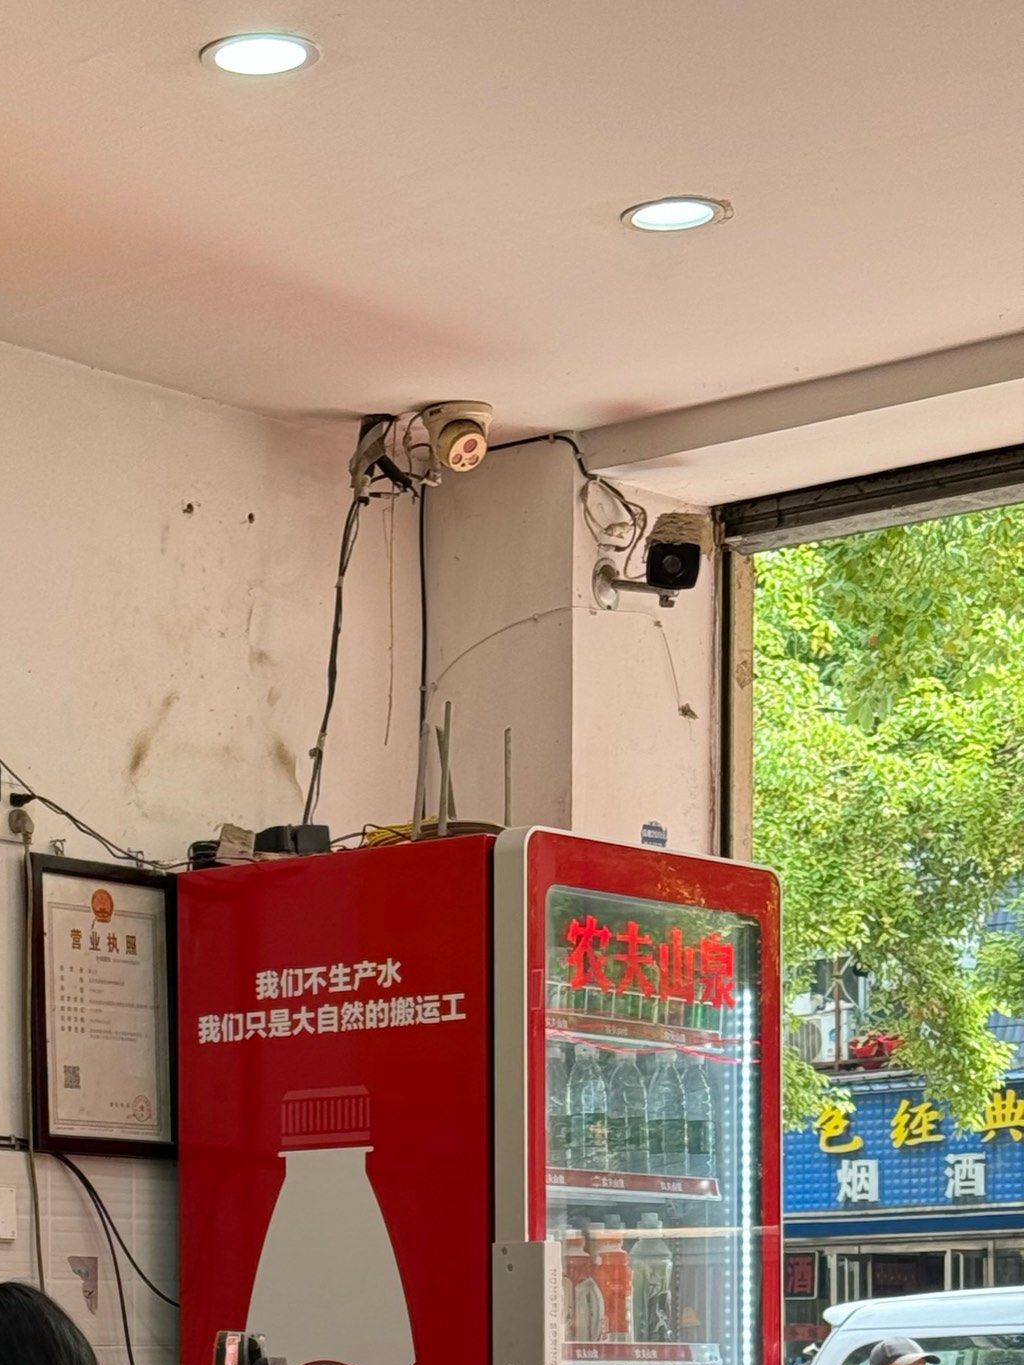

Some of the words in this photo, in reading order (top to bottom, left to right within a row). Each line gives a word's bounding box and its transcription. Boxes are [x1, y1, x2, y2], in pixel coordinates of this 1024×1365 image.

[70, 928, 138, 956] 营业执照
[566, 914, 738, 1009] 农夫山泉
[255, 957, 403, 1000] 我们不生产水
[197, 992, 467, 1044] 我们只是大自然的搬运工
[836, 1151, 987, 1204] 烟酒
